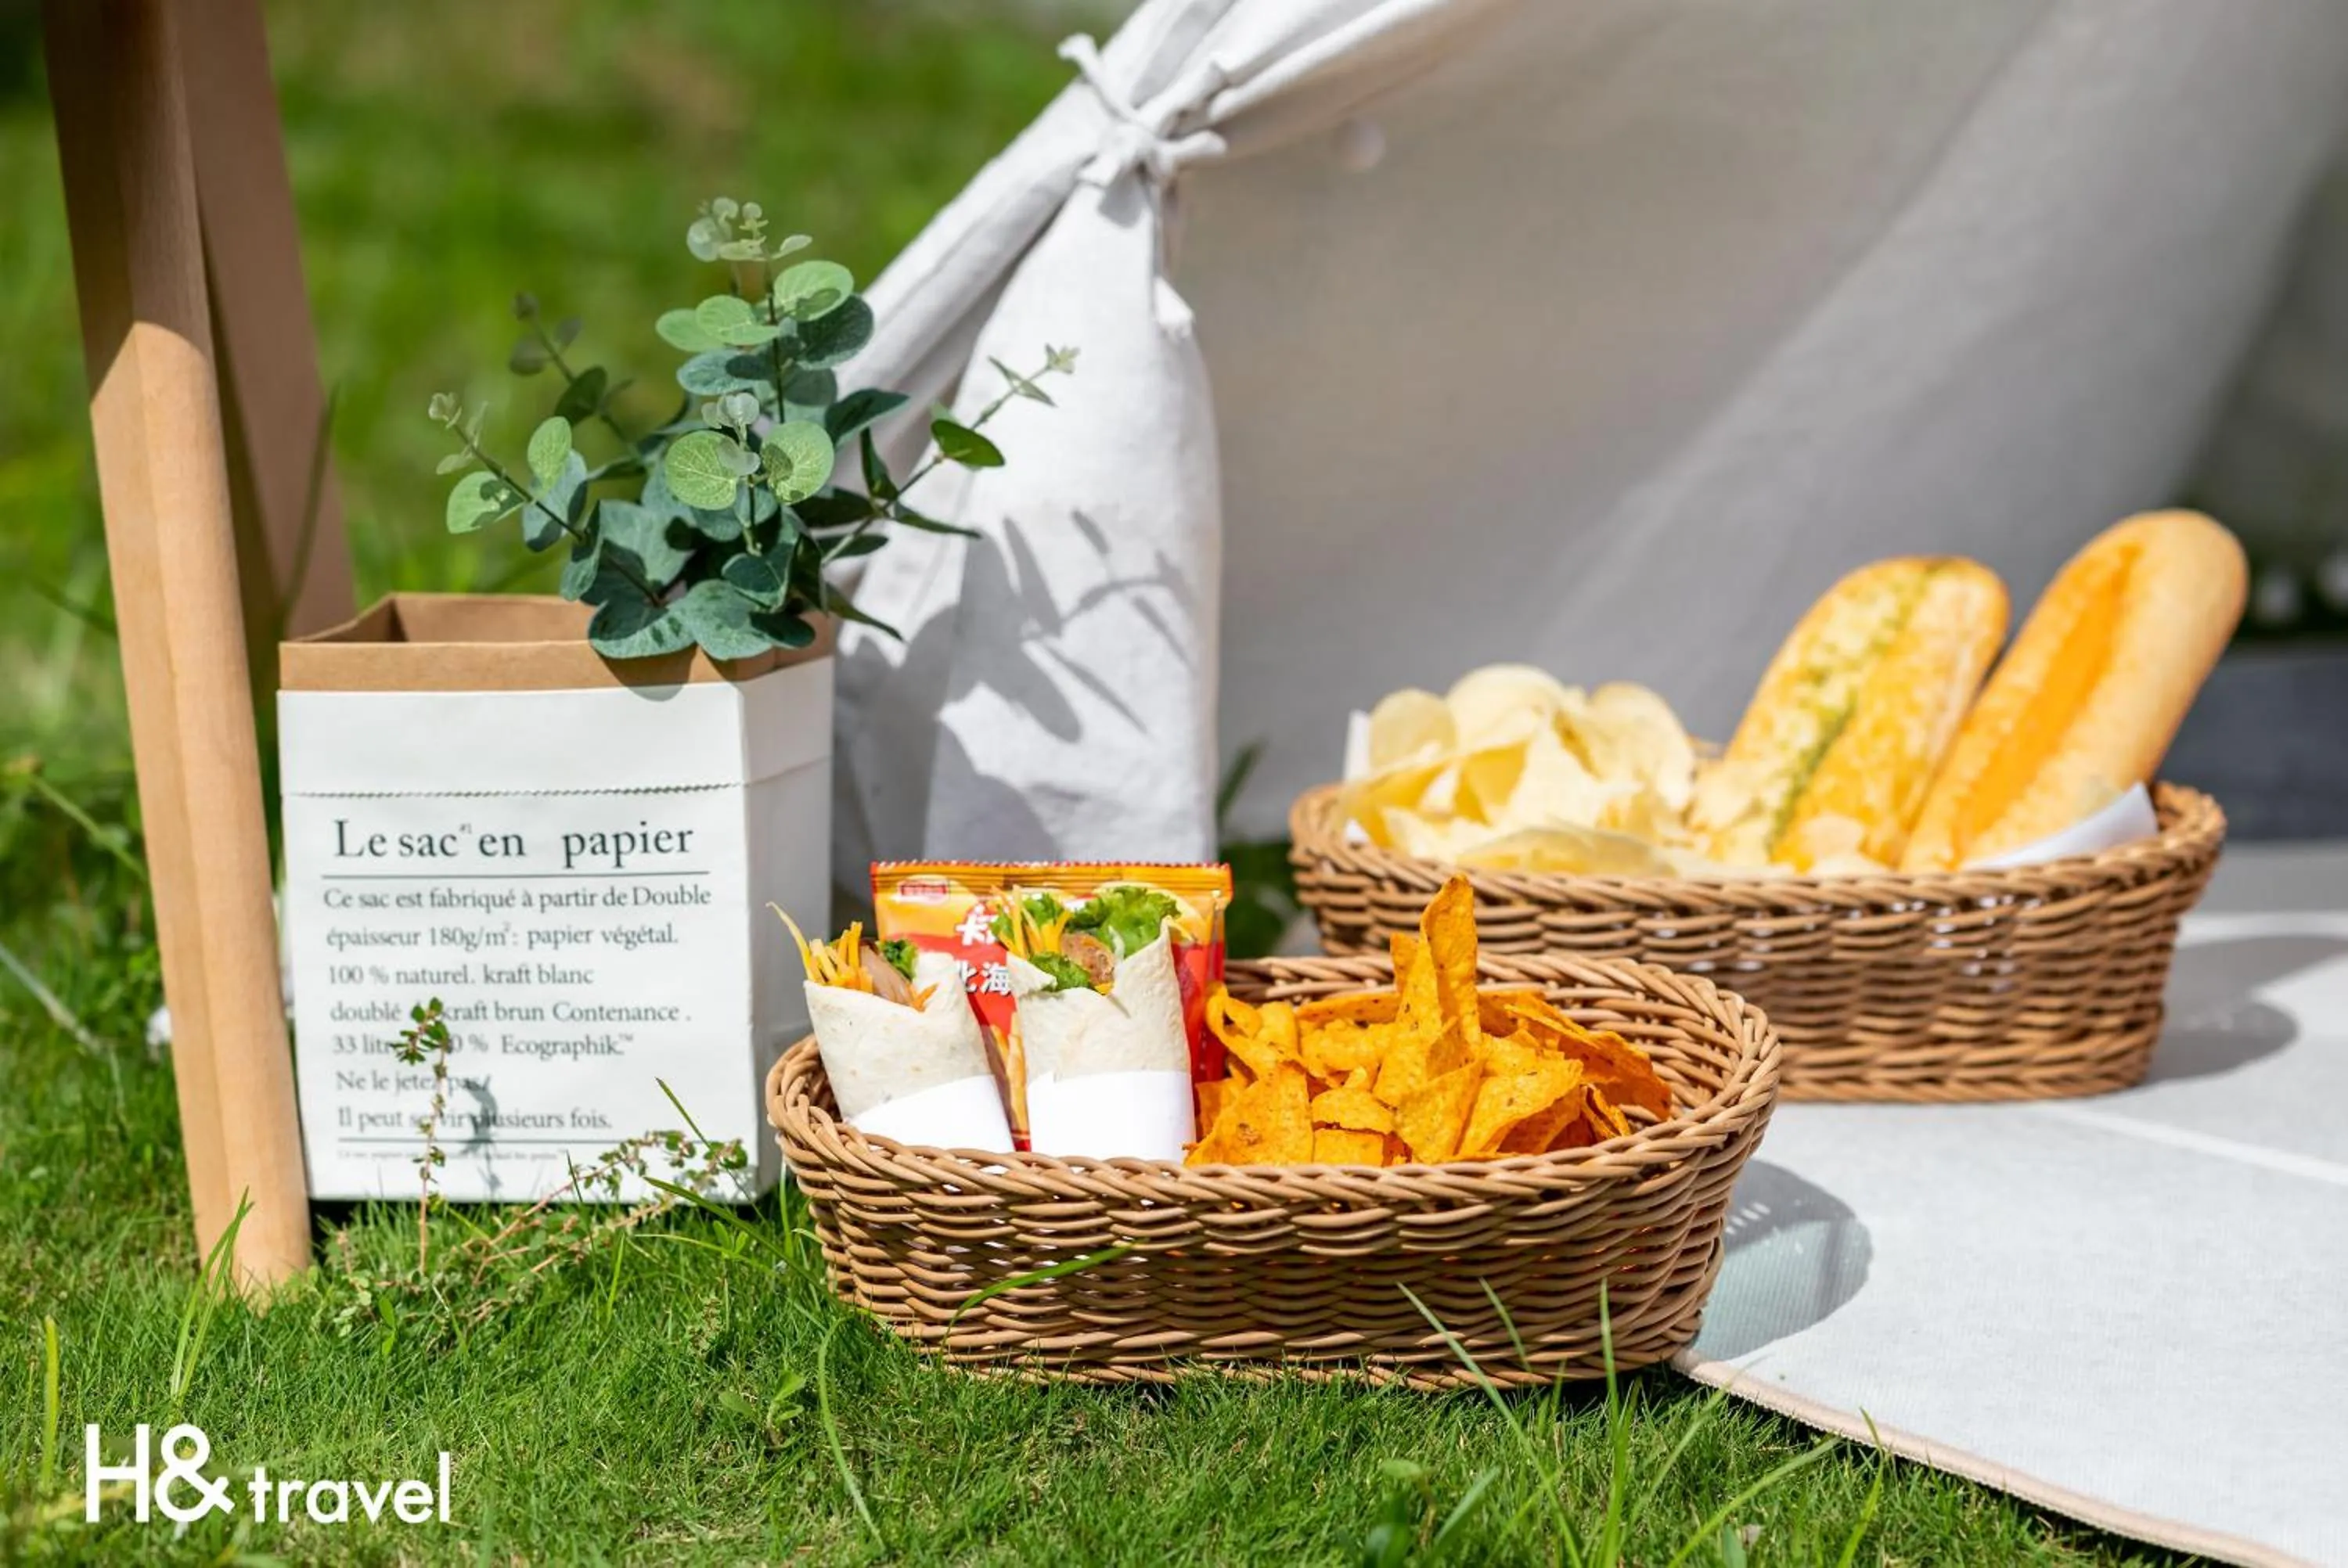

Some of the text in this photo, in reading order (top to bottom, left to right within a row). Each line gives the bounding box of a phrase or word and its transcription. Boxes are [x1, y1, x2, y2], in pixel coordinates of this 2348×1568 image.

[334, 818, 387, 858] Le
[478, 833, 528, 858] en
[561, 819, 694, 869] papier
[323, 883, 712, 916] Ce sac est fabriqué à partir de Double
[326, 926, 421, 954] épaisseur
[527, 923, 593, 951] papier
[600, 922, 679, 951] végétal.
[329, 964, 365, 985] 100
[369, 965, 391, 986] %
[481, 962, 533, 986] kraft
[536, 962, 595, 986] blanc
[330, 999, 401, 1023] doublé
[493, 999, 546, 1022] brun
[551, 999, 680, 1023] Contenance
[332, 1034, 358, 1056] 33
[335, 1070, 367, 1091] Ne
[371, 1069, 391, 1091] le
[337, 1106, 353, 1128] Il
[357, 1109, 404, 1134] peut
